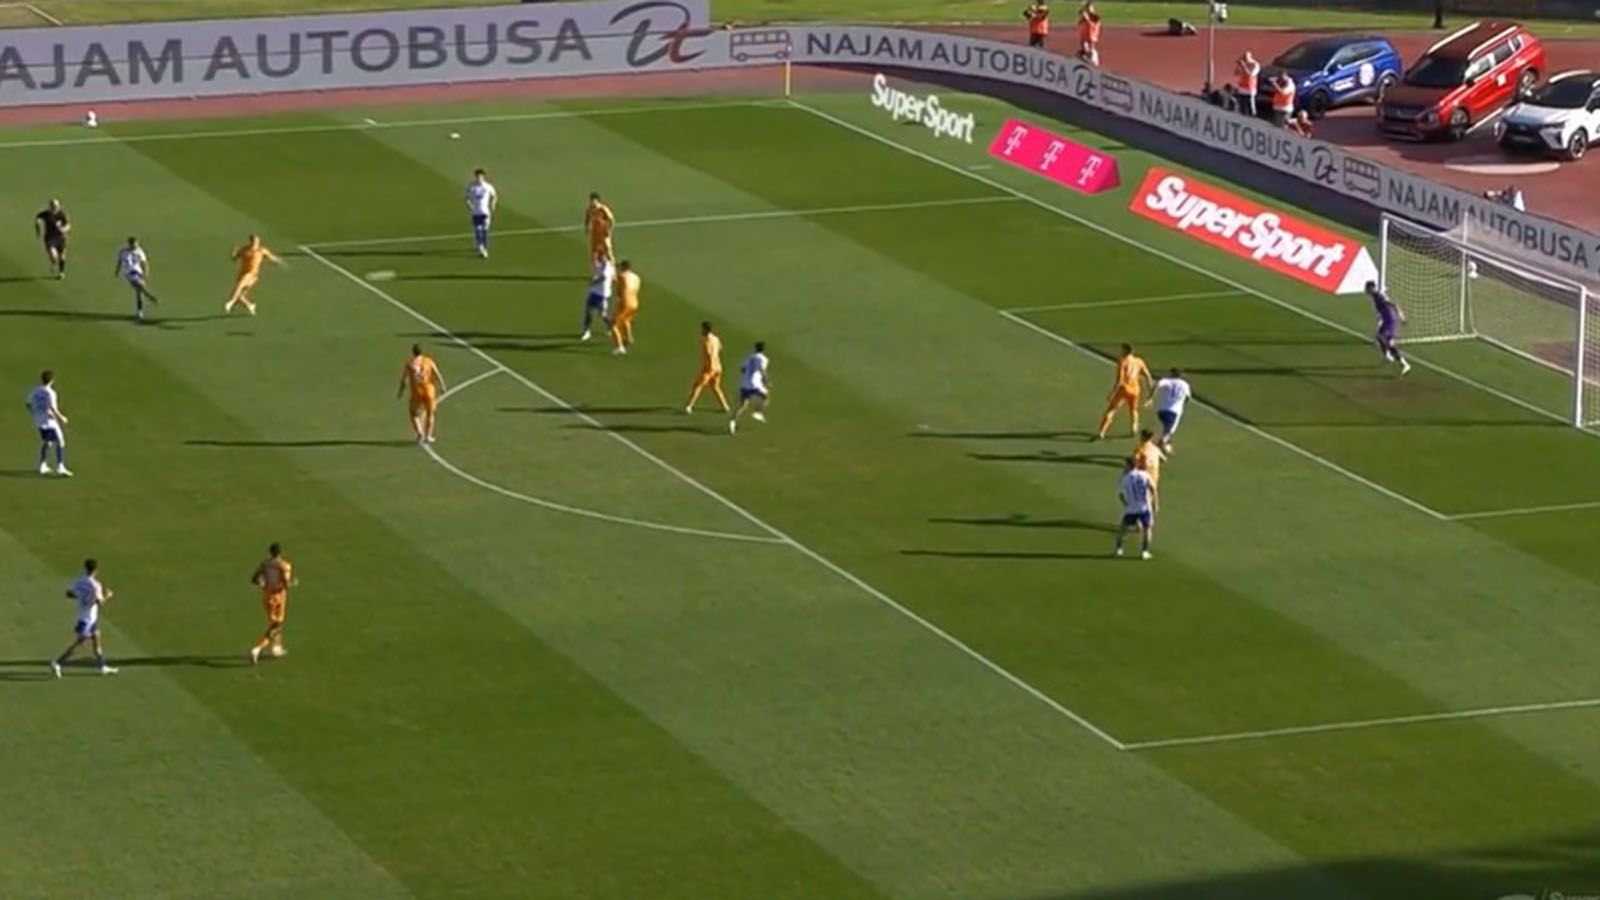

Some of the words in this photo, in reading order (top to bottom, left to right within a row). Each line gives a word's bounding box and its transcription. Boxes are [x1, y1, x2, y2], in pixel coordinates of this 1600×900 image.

[203, 17, 594, 82] AUTOBUSA
[807, 32, 924, 60] NAJAM
[930, 42, 1069, 88] AUTOBUSA
[870, 73, 976, 143] SuperSport
[1139, 92, 1199, 132] NAJAM
[1203, 116, 1307, 170] AUTOBUSA
[1145, 175, 1346, 277] SuperSport
[1388, 178, 1460, 226] NAJAM
